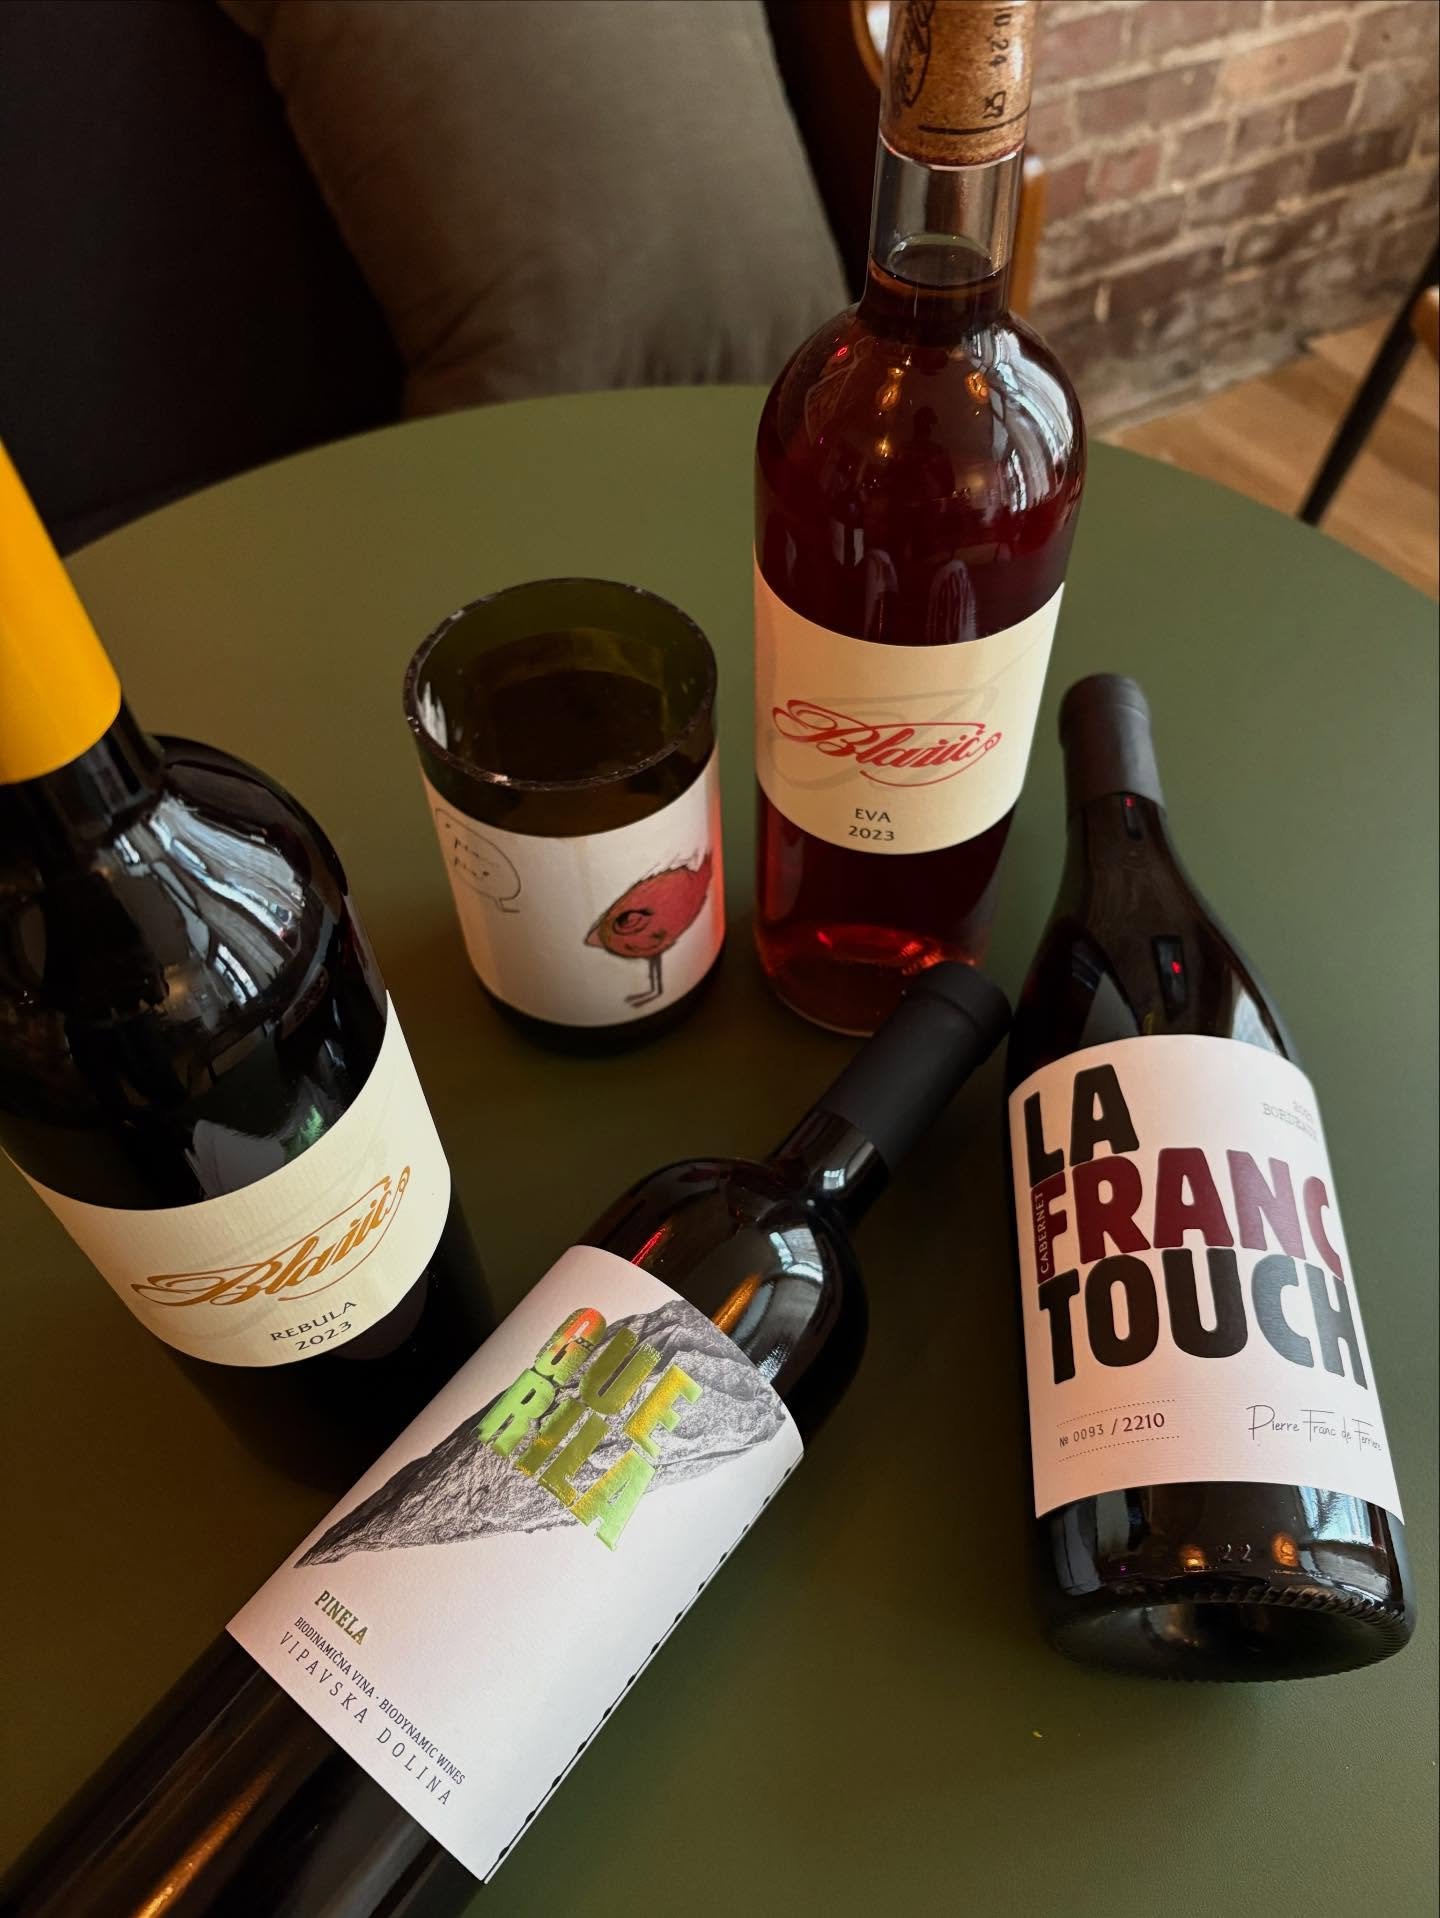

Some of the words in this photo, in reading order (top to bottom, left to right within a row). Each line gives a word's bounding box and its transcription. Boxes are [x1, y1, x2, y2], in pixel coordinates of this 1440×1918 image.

[848, 825, 896, 842] 2023
[854, 807, 892, 824] EVA
[1024, 1063, 1140, 1189] LA
[1030, 1147, 1345, 1285] FRANC
[1035, 1191, 1051, 1274] CABERNET
[269, 1301, 358, 1341] REBULA
[295, 1320, 352, 1351] 2023
[1038, 1247, 1369, 1391] TOUCH
[1073, 1423, 1105, 1443] 0093
[1122, 1412, 1166, 1433] 2210
[1246, 1404, 1300, 1441] Pierre
[1299, 1408, 1337, 1443] Franc
[314, 1589, 369, 1646] PINELA
[279, 1631, 369, 1724] VIPAVSKA
[376, 1727, 451, 1805] DOLINA
[294, 1616, 352, 1676] BIODINAMIČNA
[351, 1670, 376, 1698] VINA
[378, 1698, 440, 1759] BIODYNAMIC
[436, 1753, 466, 1785] WINES
